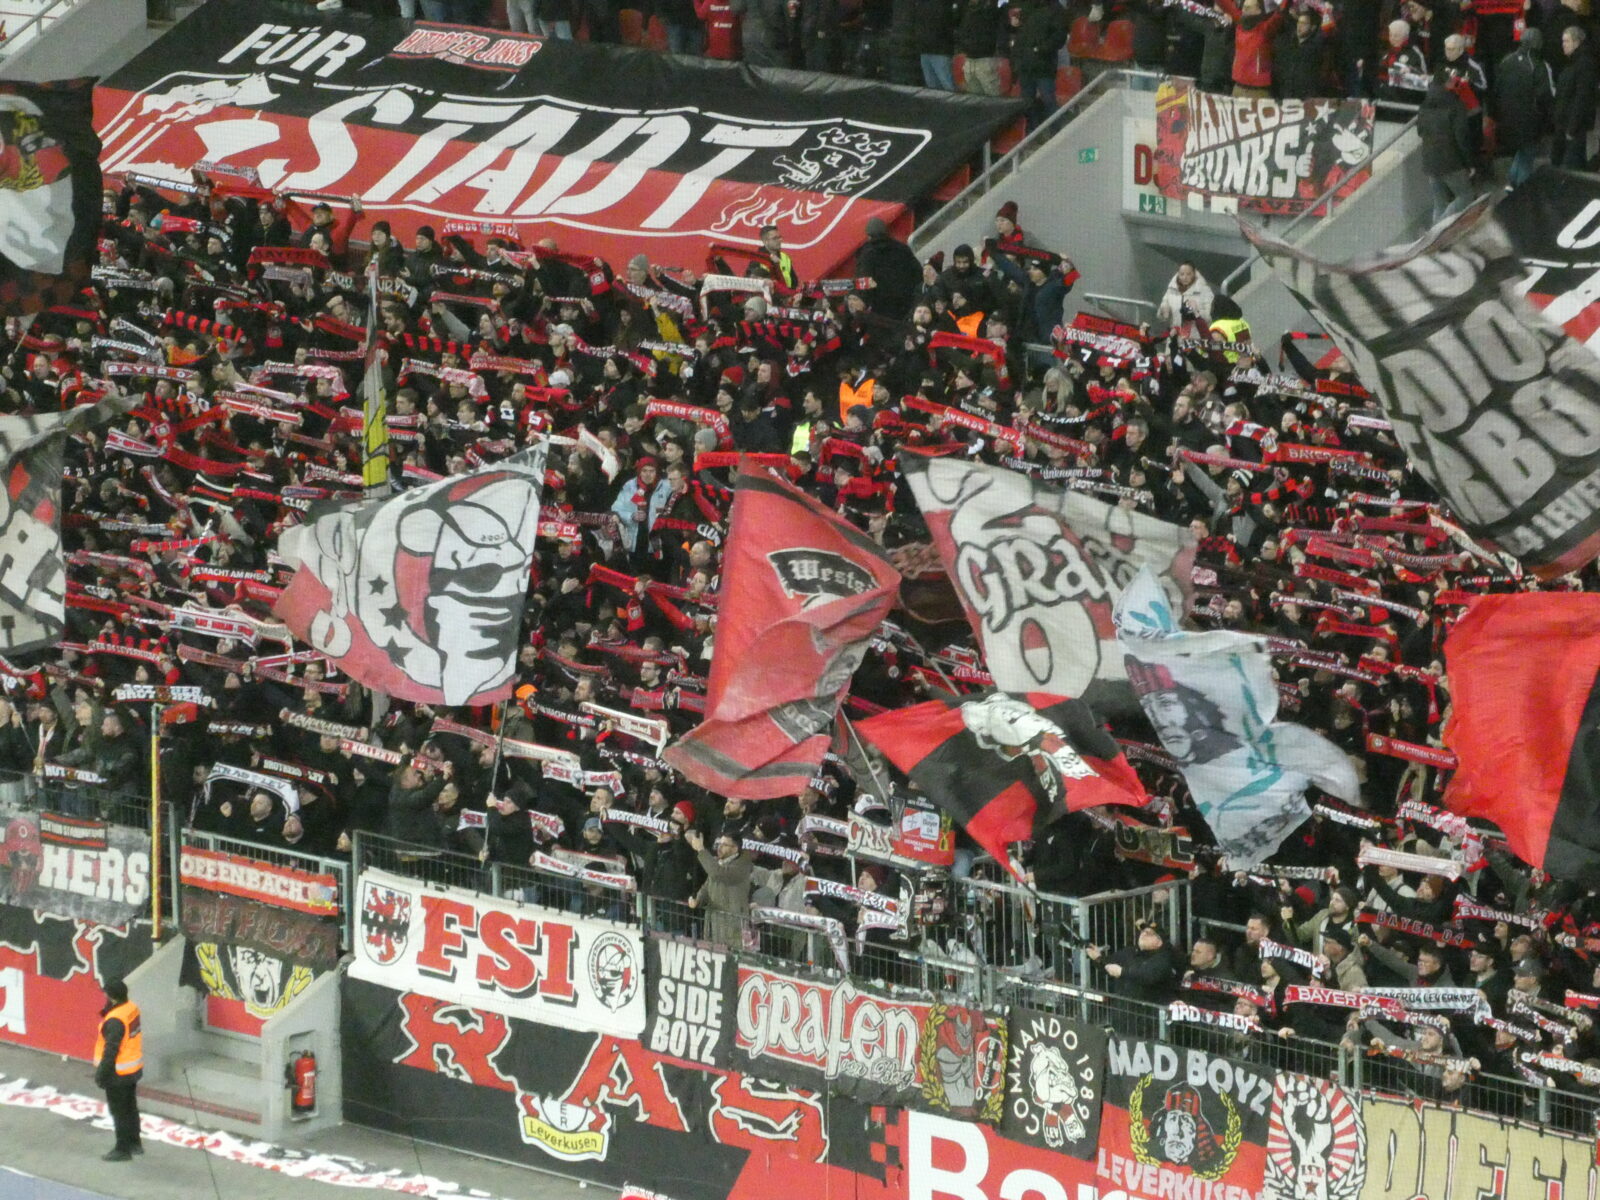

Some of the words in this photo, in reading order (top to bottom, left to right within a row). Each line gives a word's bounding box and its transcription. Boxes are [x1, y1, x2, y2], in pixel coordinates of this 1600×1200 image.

[219, 23, 366, 79] FÜR
[258, 88, 808, 229] STADT
[108, 364, 168, 377] BAYER
[1376, 911, 1434, 937] BAYER
[416, 895, 580, 1008] FSI
[659, 939, 726, 989] WEST
[657, 977, 724, 1029] SIDE
[1298, 988, 1359, 1006] BAYER
[651, 1015, 720, 1066] BOYZ
[1008, 1017, 1078, 1135] COMMANDO
[1075, 1054, 1095, 1120] 1989
[1108, 1038, 1178, 1080] MAD
[1187, 1049, 1273, 1117] BOYZ
[530, 1120, 598, 1154] Leverkusen
